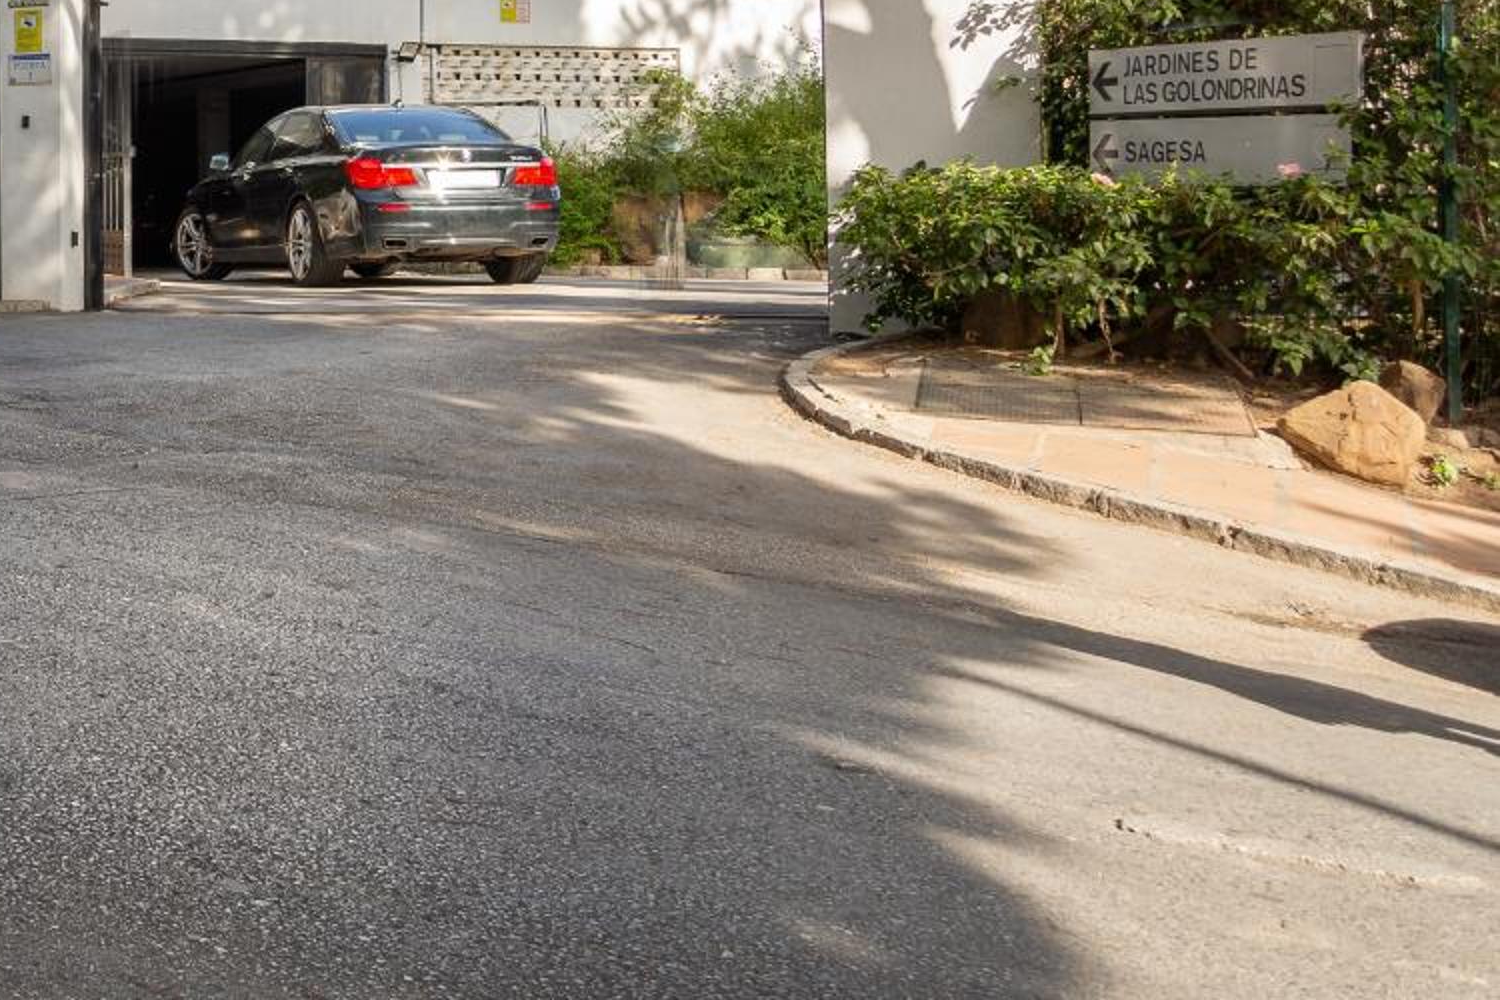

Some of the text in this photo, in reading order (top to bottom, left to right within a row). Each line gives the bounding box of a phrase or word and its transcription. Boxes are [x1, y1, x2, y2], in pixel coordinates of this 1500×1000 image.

[1123, 47, 1258, 78] JARDINES DE
[1123, 74, 1306, 105] LAS GOLONDRINAS
[1124, 140, 1206, 164] SAGESA
